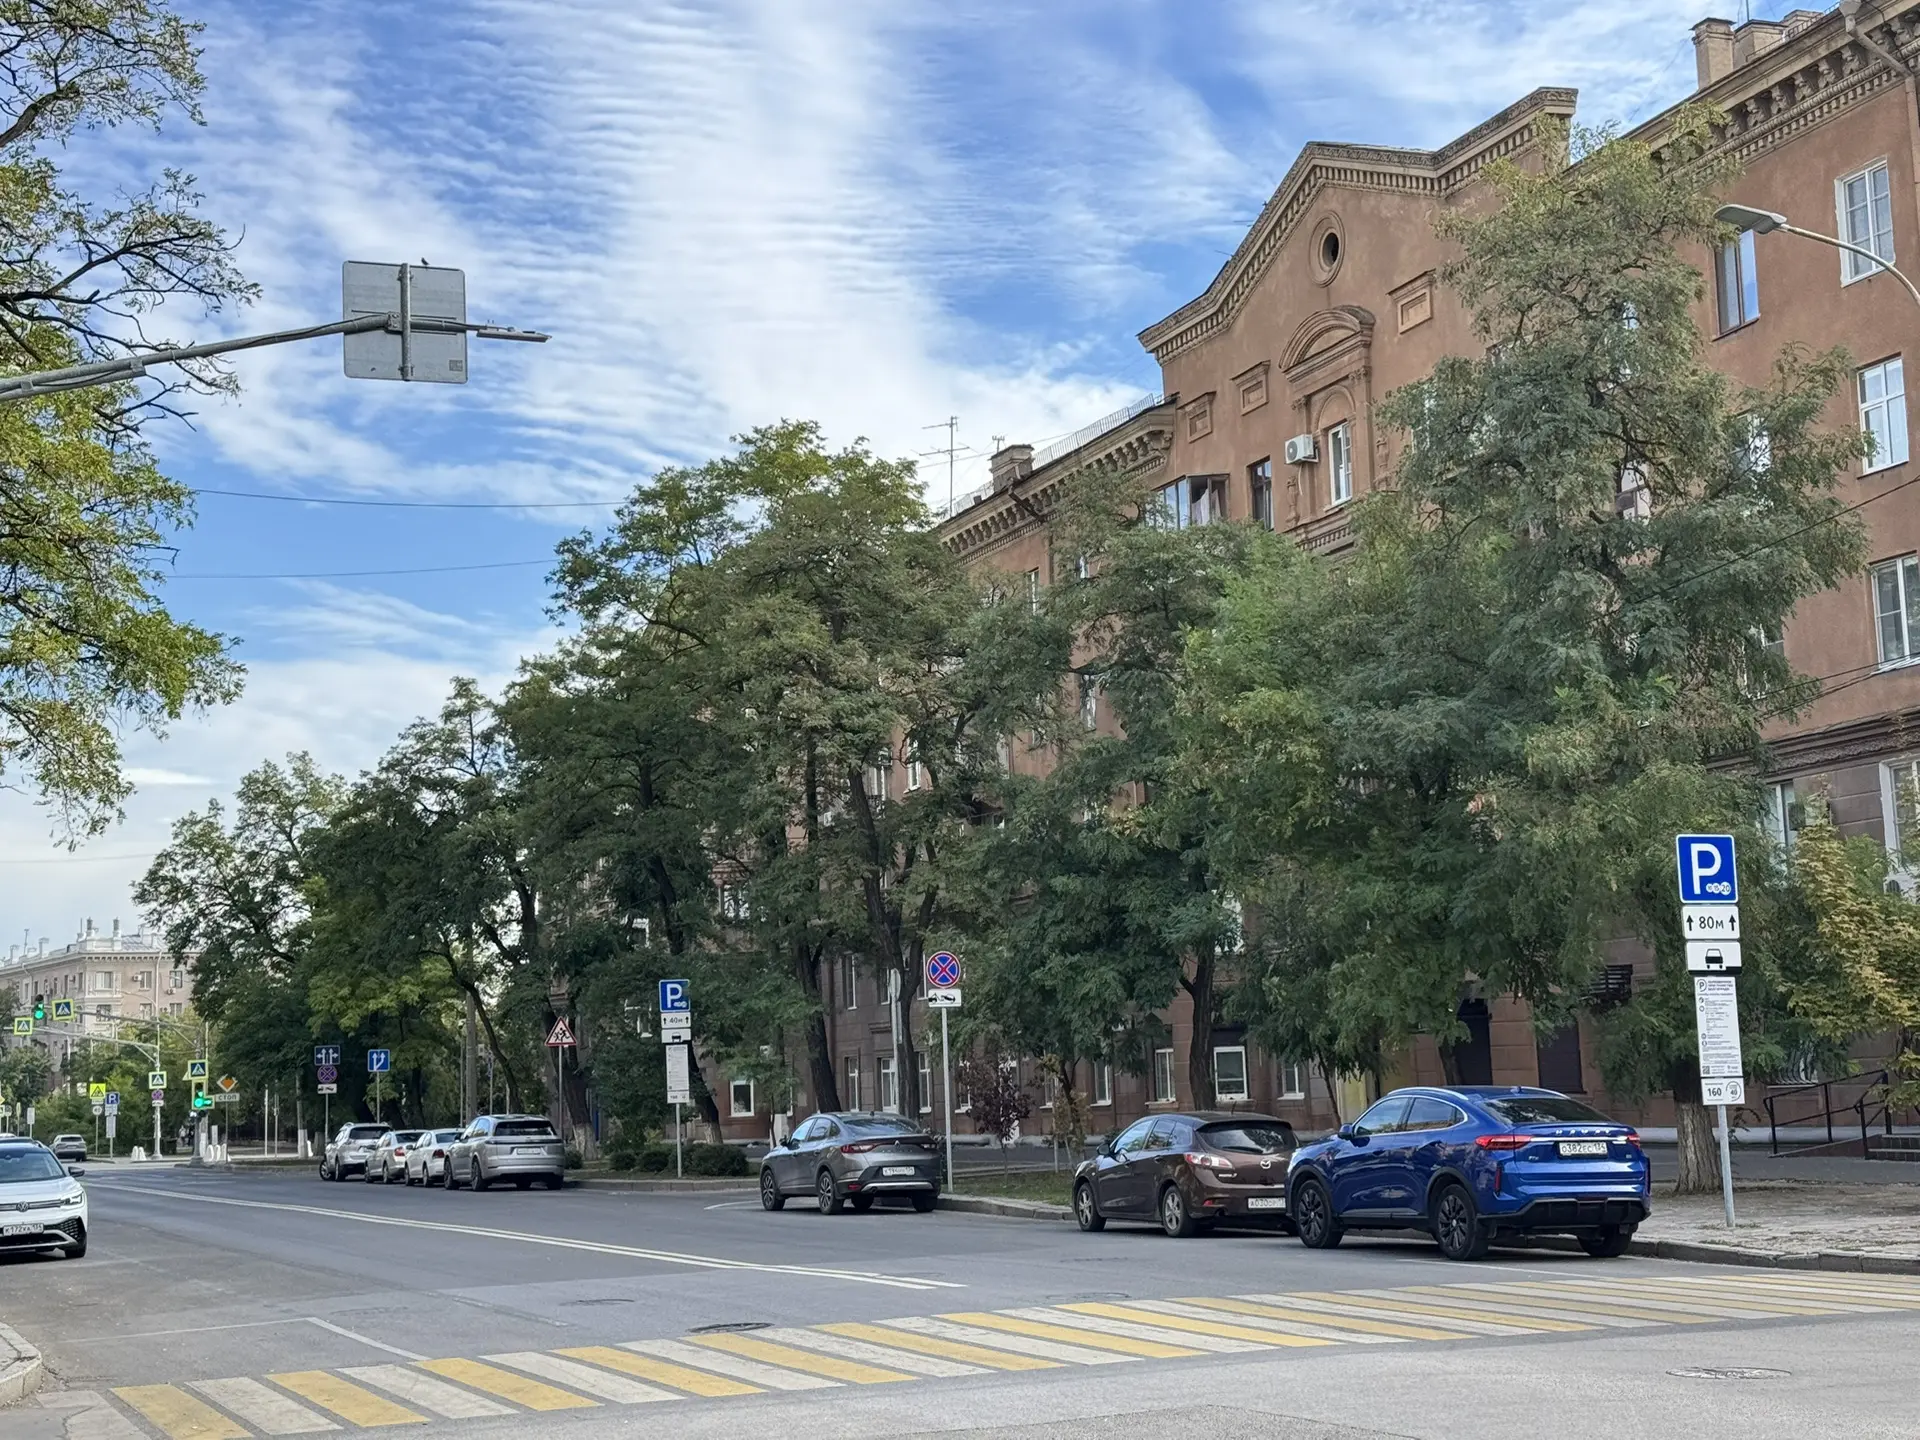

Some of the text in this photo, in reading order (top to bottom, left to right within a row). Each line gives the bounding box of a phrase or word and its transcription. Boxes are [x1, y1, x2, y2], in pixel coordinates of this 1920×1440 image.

[1690, 843, 1722, 895] P
[1721, 884, 1730, 892] 20
[666, 983, 682, 1008] P
[1708, 1087, 1722, 1096] 160
